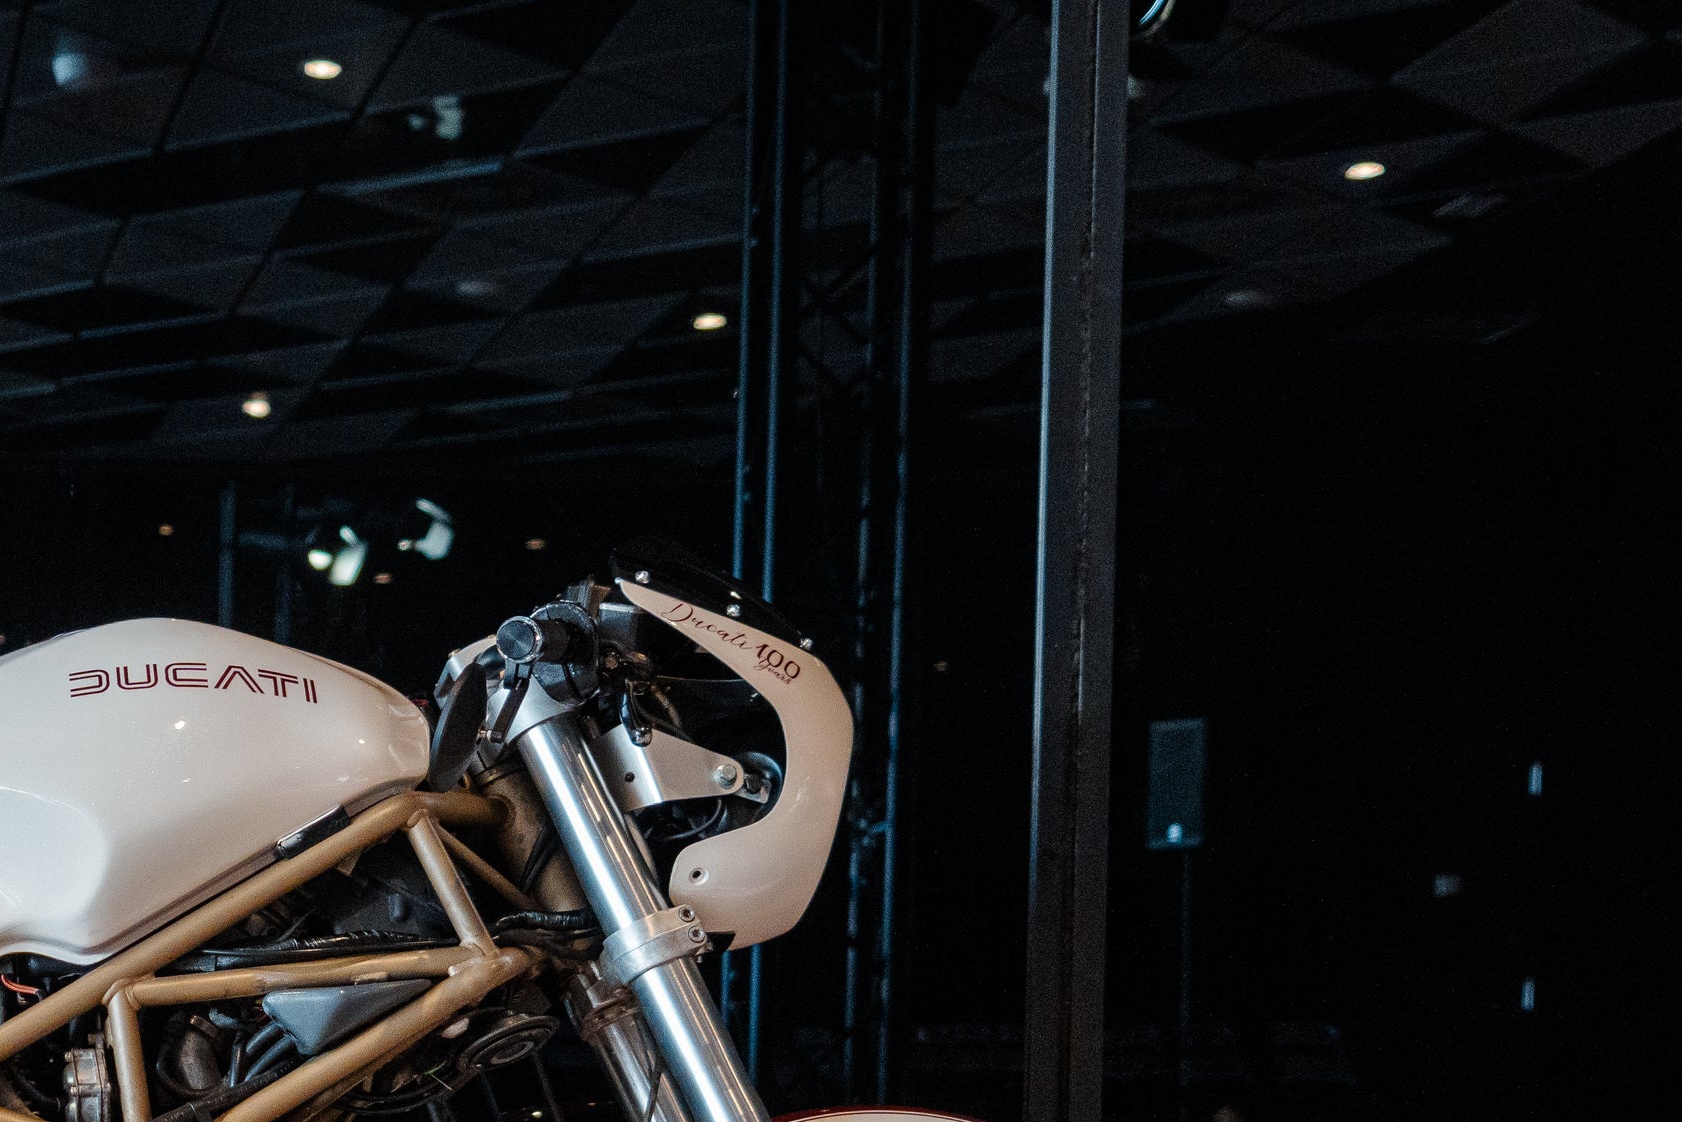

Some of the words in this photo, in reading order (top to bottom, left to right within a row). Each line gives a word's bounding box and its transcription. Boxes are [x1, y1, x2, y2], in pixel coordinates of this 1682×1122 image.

[660, 602, 753, 650] Ducati
[755, 643, 801, 680] 100
[68, 662, 318, 704] DUCATI
